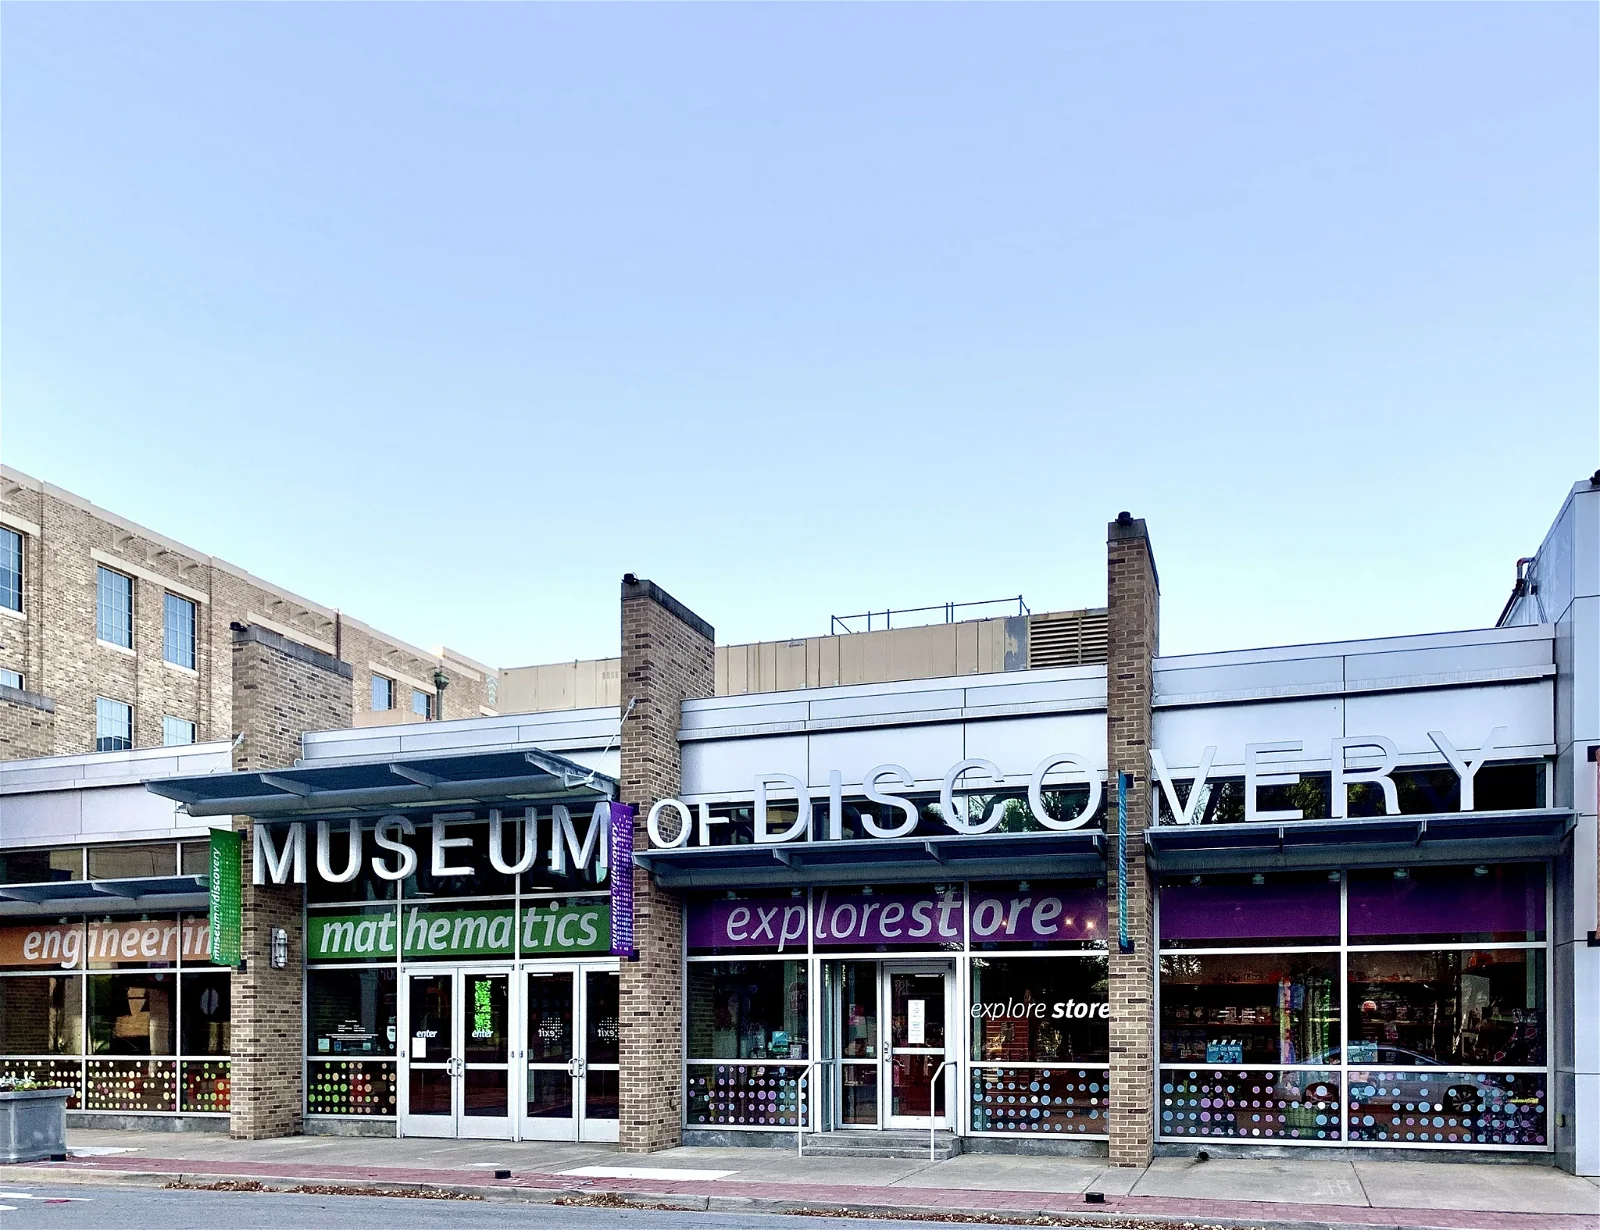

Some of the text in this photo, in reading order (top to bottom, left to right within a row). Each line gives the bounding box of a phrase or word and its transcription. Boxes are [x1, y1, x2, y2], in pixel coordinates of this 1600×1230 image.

[251, 725, 1507, 886] MUSEUM OF DISCOVERY
[22, 915, 211, 969] engineerin
[319, 900, 600, 954] mathematics
[971, 997, 1109, 1021] explore store
[416, 1029, 438, 1038] enter
[472, 1029, 494, 1038] enter
